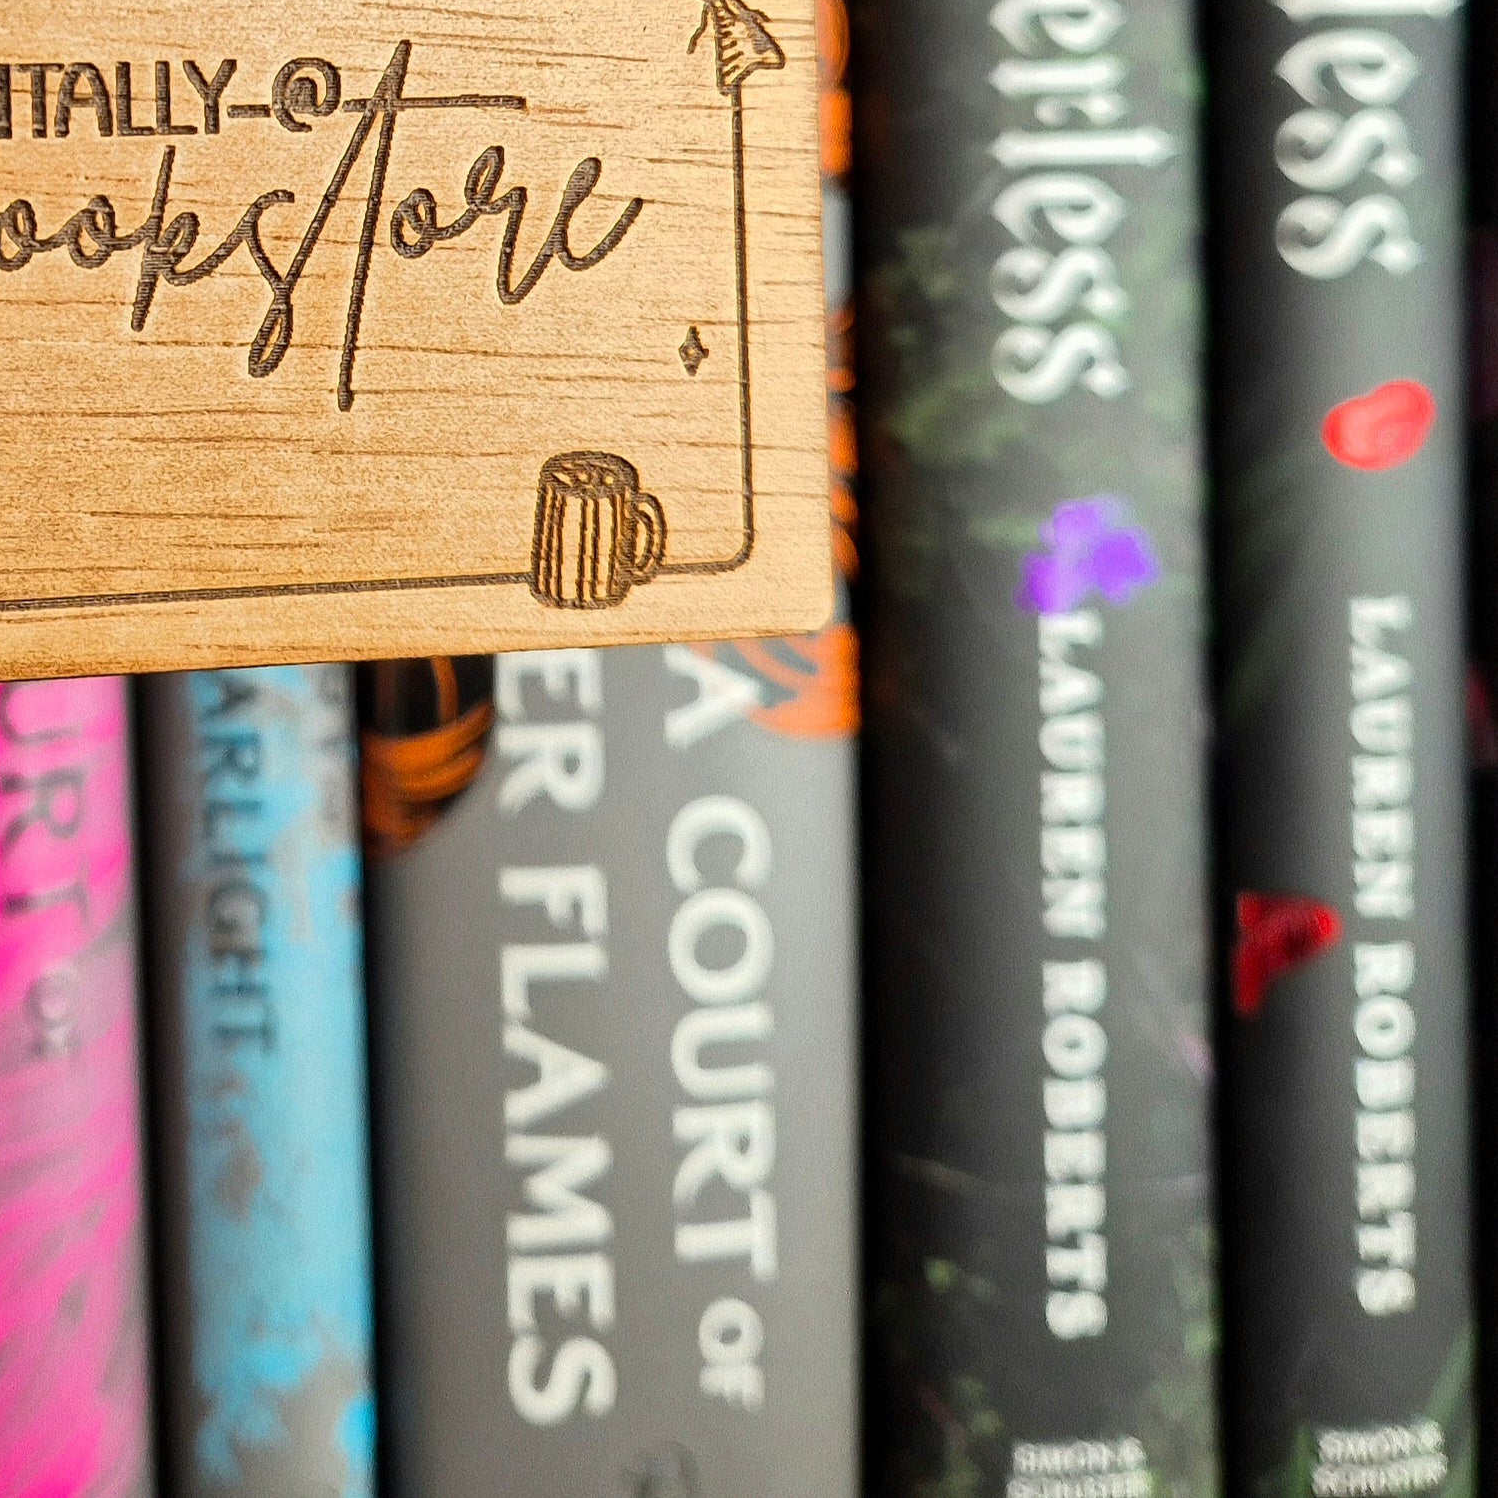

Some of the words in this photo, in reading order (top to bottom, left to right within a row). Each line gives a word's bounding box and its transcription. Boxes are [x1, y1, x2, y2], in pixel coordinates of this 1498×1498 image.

[663, 644, 760, 748] A
[1037, 607, 1108, 940] LAUREN
[1348, 596, 1415, 919] LAUREN
[500, 863, 618, 1426] FLAMES
[666, 795, 780, 1282] COURT
[1041, 959, 1109, 1340] ROBERTS
[1352, 941, 1419, 1317] ROBERTS
[699, 1298, 765, 1415] OF
